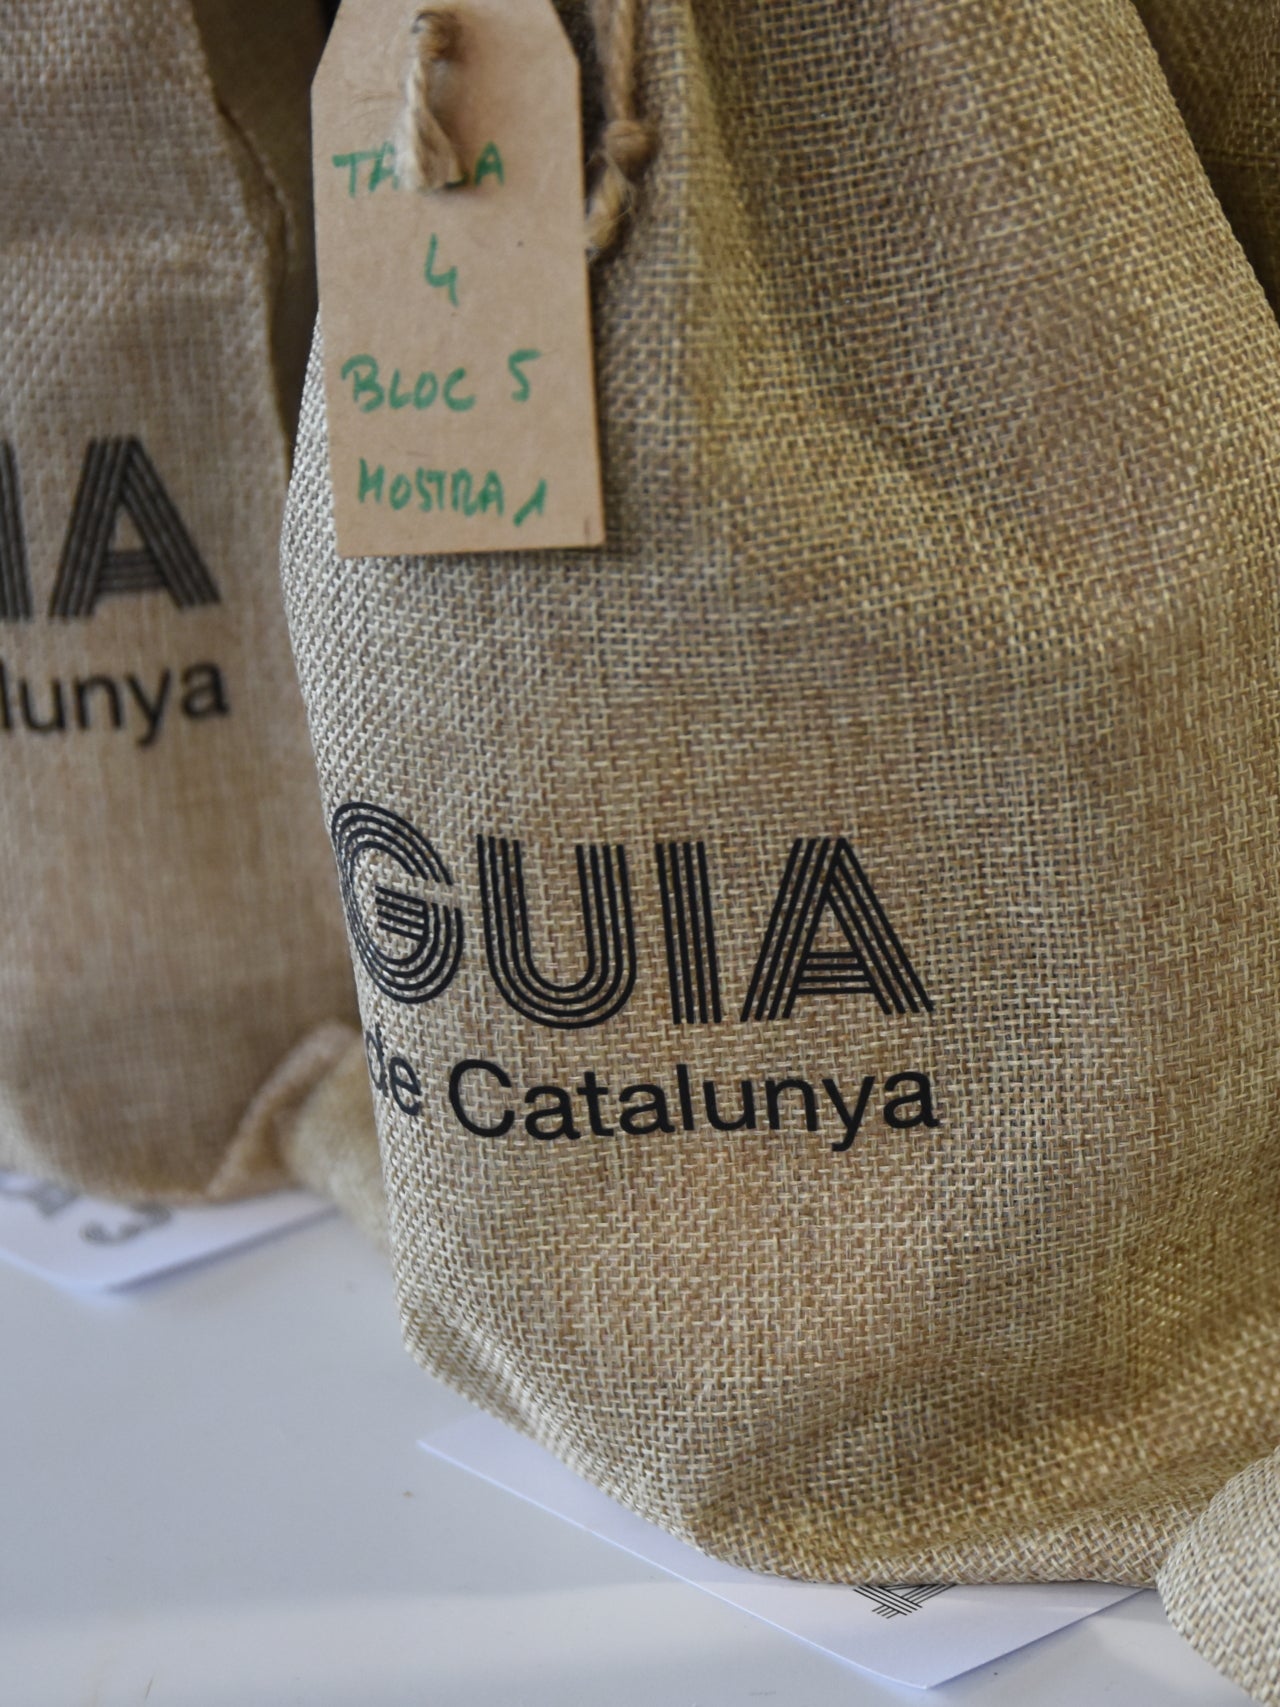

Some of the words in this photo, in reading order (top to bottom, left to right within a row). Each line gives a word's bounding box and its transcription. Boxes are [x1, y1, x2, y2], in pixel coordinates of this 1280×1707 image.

[331, 140, 504, 197] TAA
[424, 233, 458, 306] 4
[342, 354, 475, 413] BLOC
[508, 348, 540, 402] 5
[358, 458, 504, 518] MOSTRA
[333, 801, 934, 1030] GUIA
[448, 1058, 940, 1152] Catalunya
